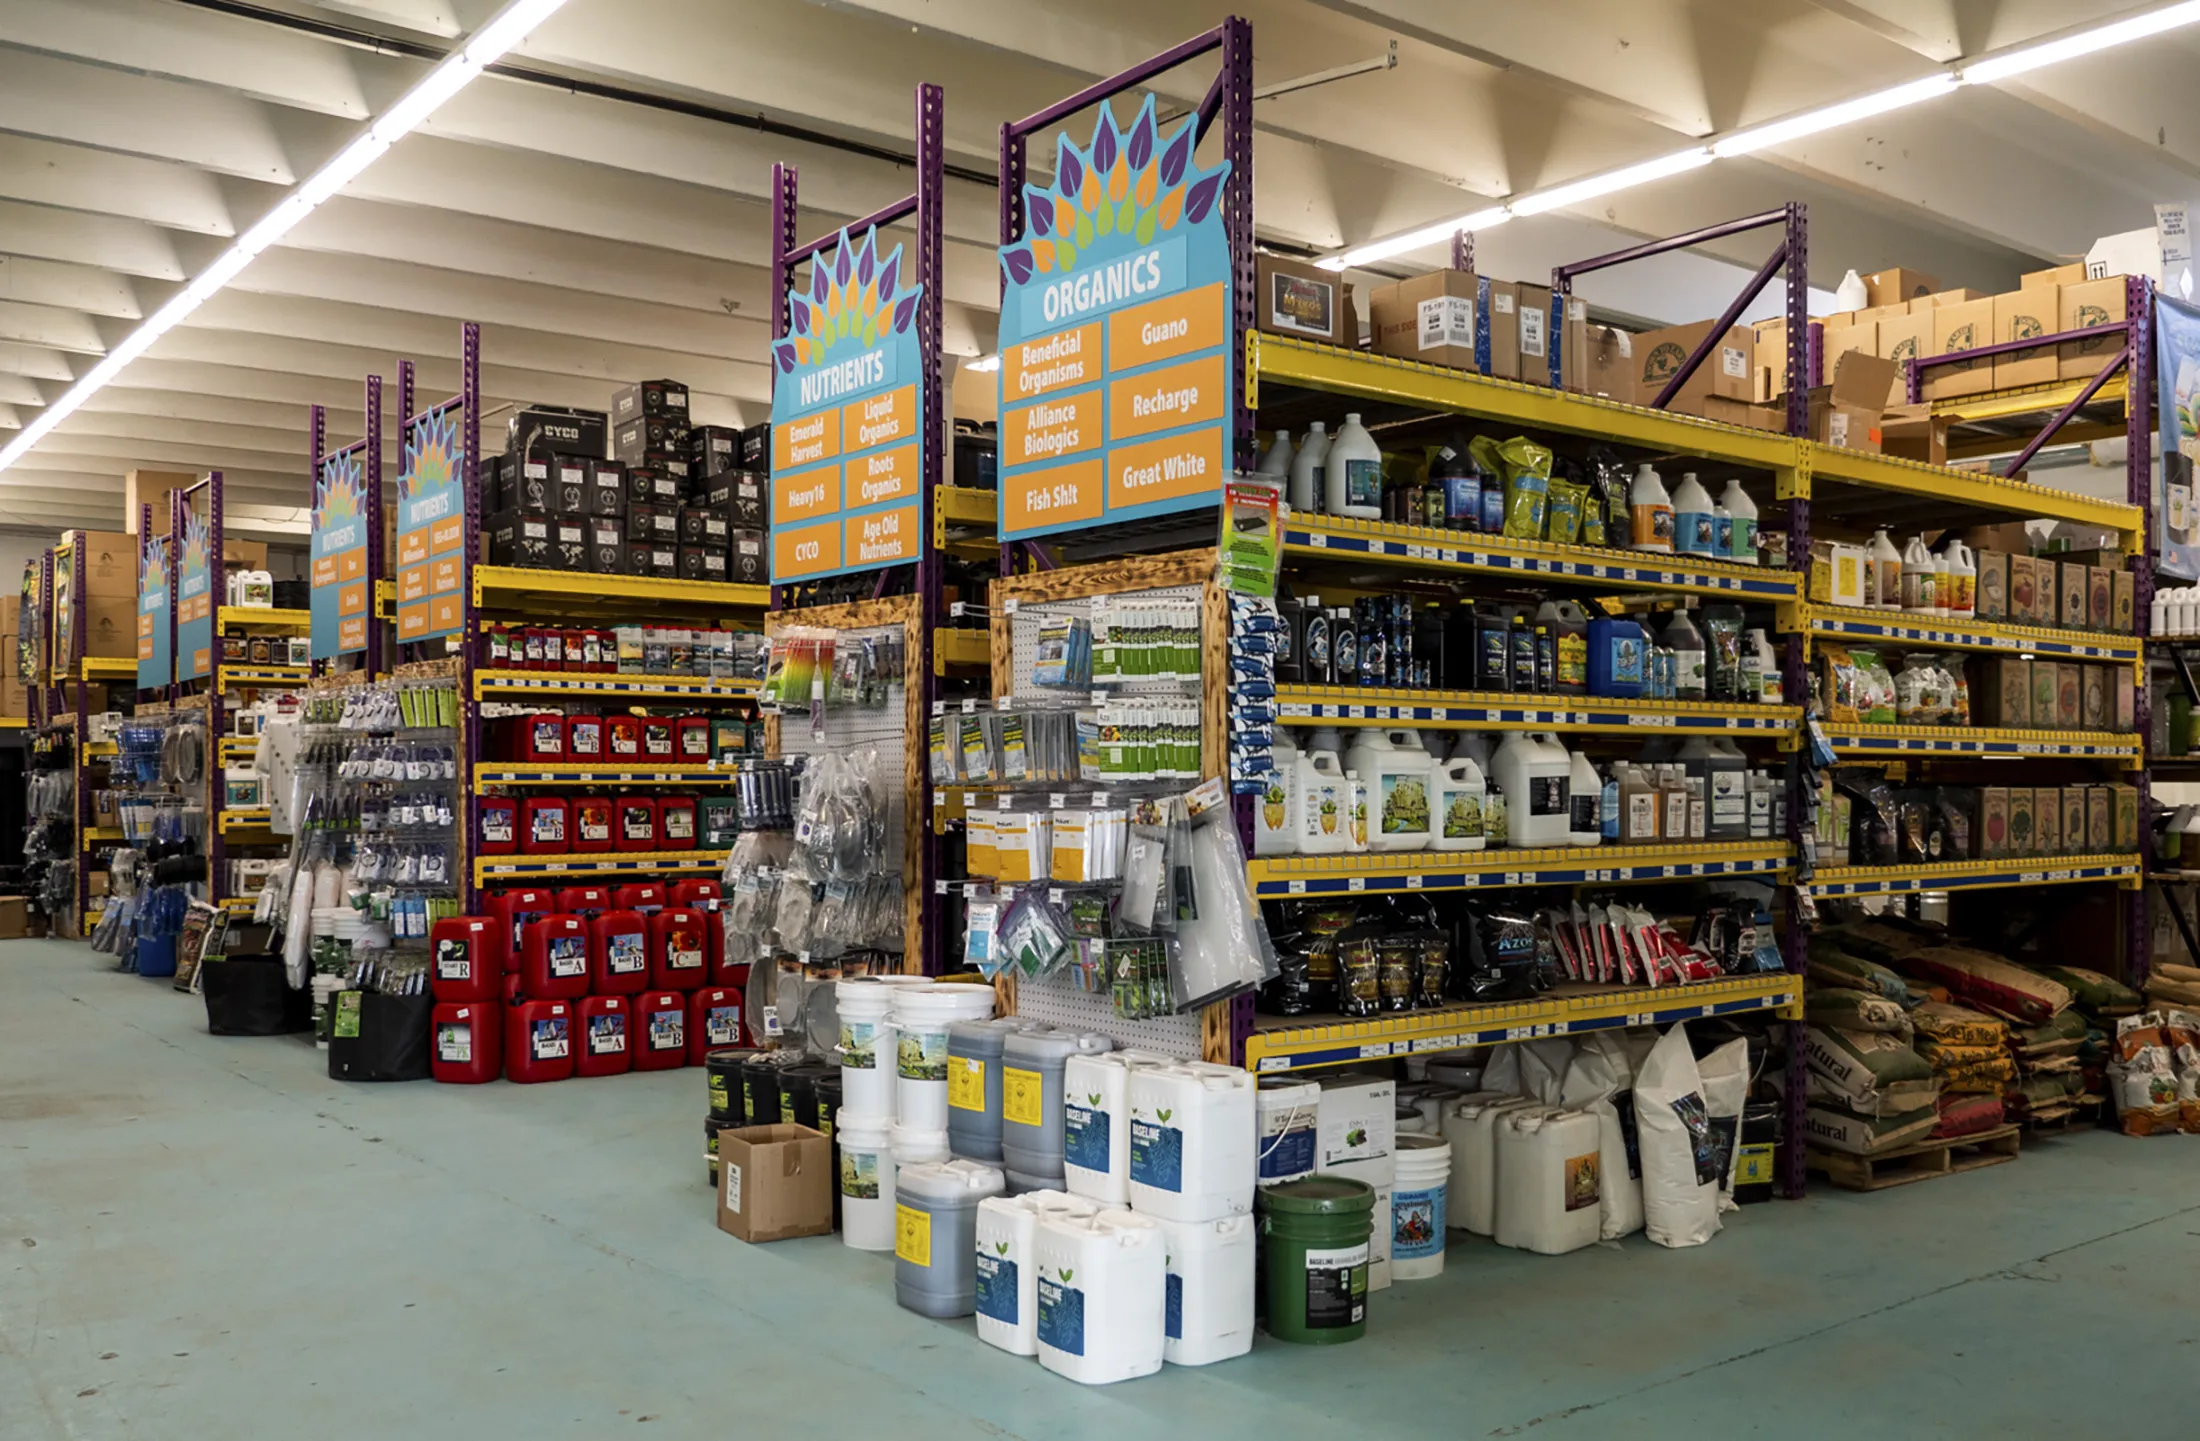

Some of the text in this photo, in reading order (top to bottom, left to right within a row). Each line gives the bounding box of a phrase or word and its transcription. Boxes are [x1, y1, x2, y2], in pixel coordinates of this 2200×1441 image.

[1043, 250, 1161, 322] ORGANICS
[1141, 316, 1188, 346] Guano
[1022, 332, 1081, 368] Beneficial
[801, 349, 884, 407] NUTRIENTS
[1019, 360, 1084, 396] Organisms
[865, 394, 893, 421] Liquid
[1133, 384, 1199, 417] Recharge
[790, 417, 824, 443] Emerald
[859, 416, 899, 445] Organics
[1027, 404, 1076, 432] Alliance
[544, 424, 579, 439] CYCO
[1024, 427, 1080, 457] Biologics
[791, 439, 823, 464] Harvest
[868, 455, 895, 477] Roots
[1123, 455, 1206, 489] Great White
[789, 483, 825, 509] Heavy16
[862, 472, 901, 500] Organics
[1026, 482, 1079, 511] Fish Sh!t
[863, 513, 899, 542] Age Old
[795, 539, 819, 562] CYCO
[860, 536, 902, 561] Nutrients
[459, 963, 468, 977] R
[573, 959, 583, 973] A
[633, 956, 642, 969] B
[612, 1037, 622, 1050] A
[673, 1033, 681, 1046] B
[729, 1028, 738, 1041] B
[556, 1042, 566, 1055] A
[1805, 1040, 1853, 1082] atural
[1803, 1117, 1847, 1142] atural
[1309, 1256, 1334, 1266] BASELINE
